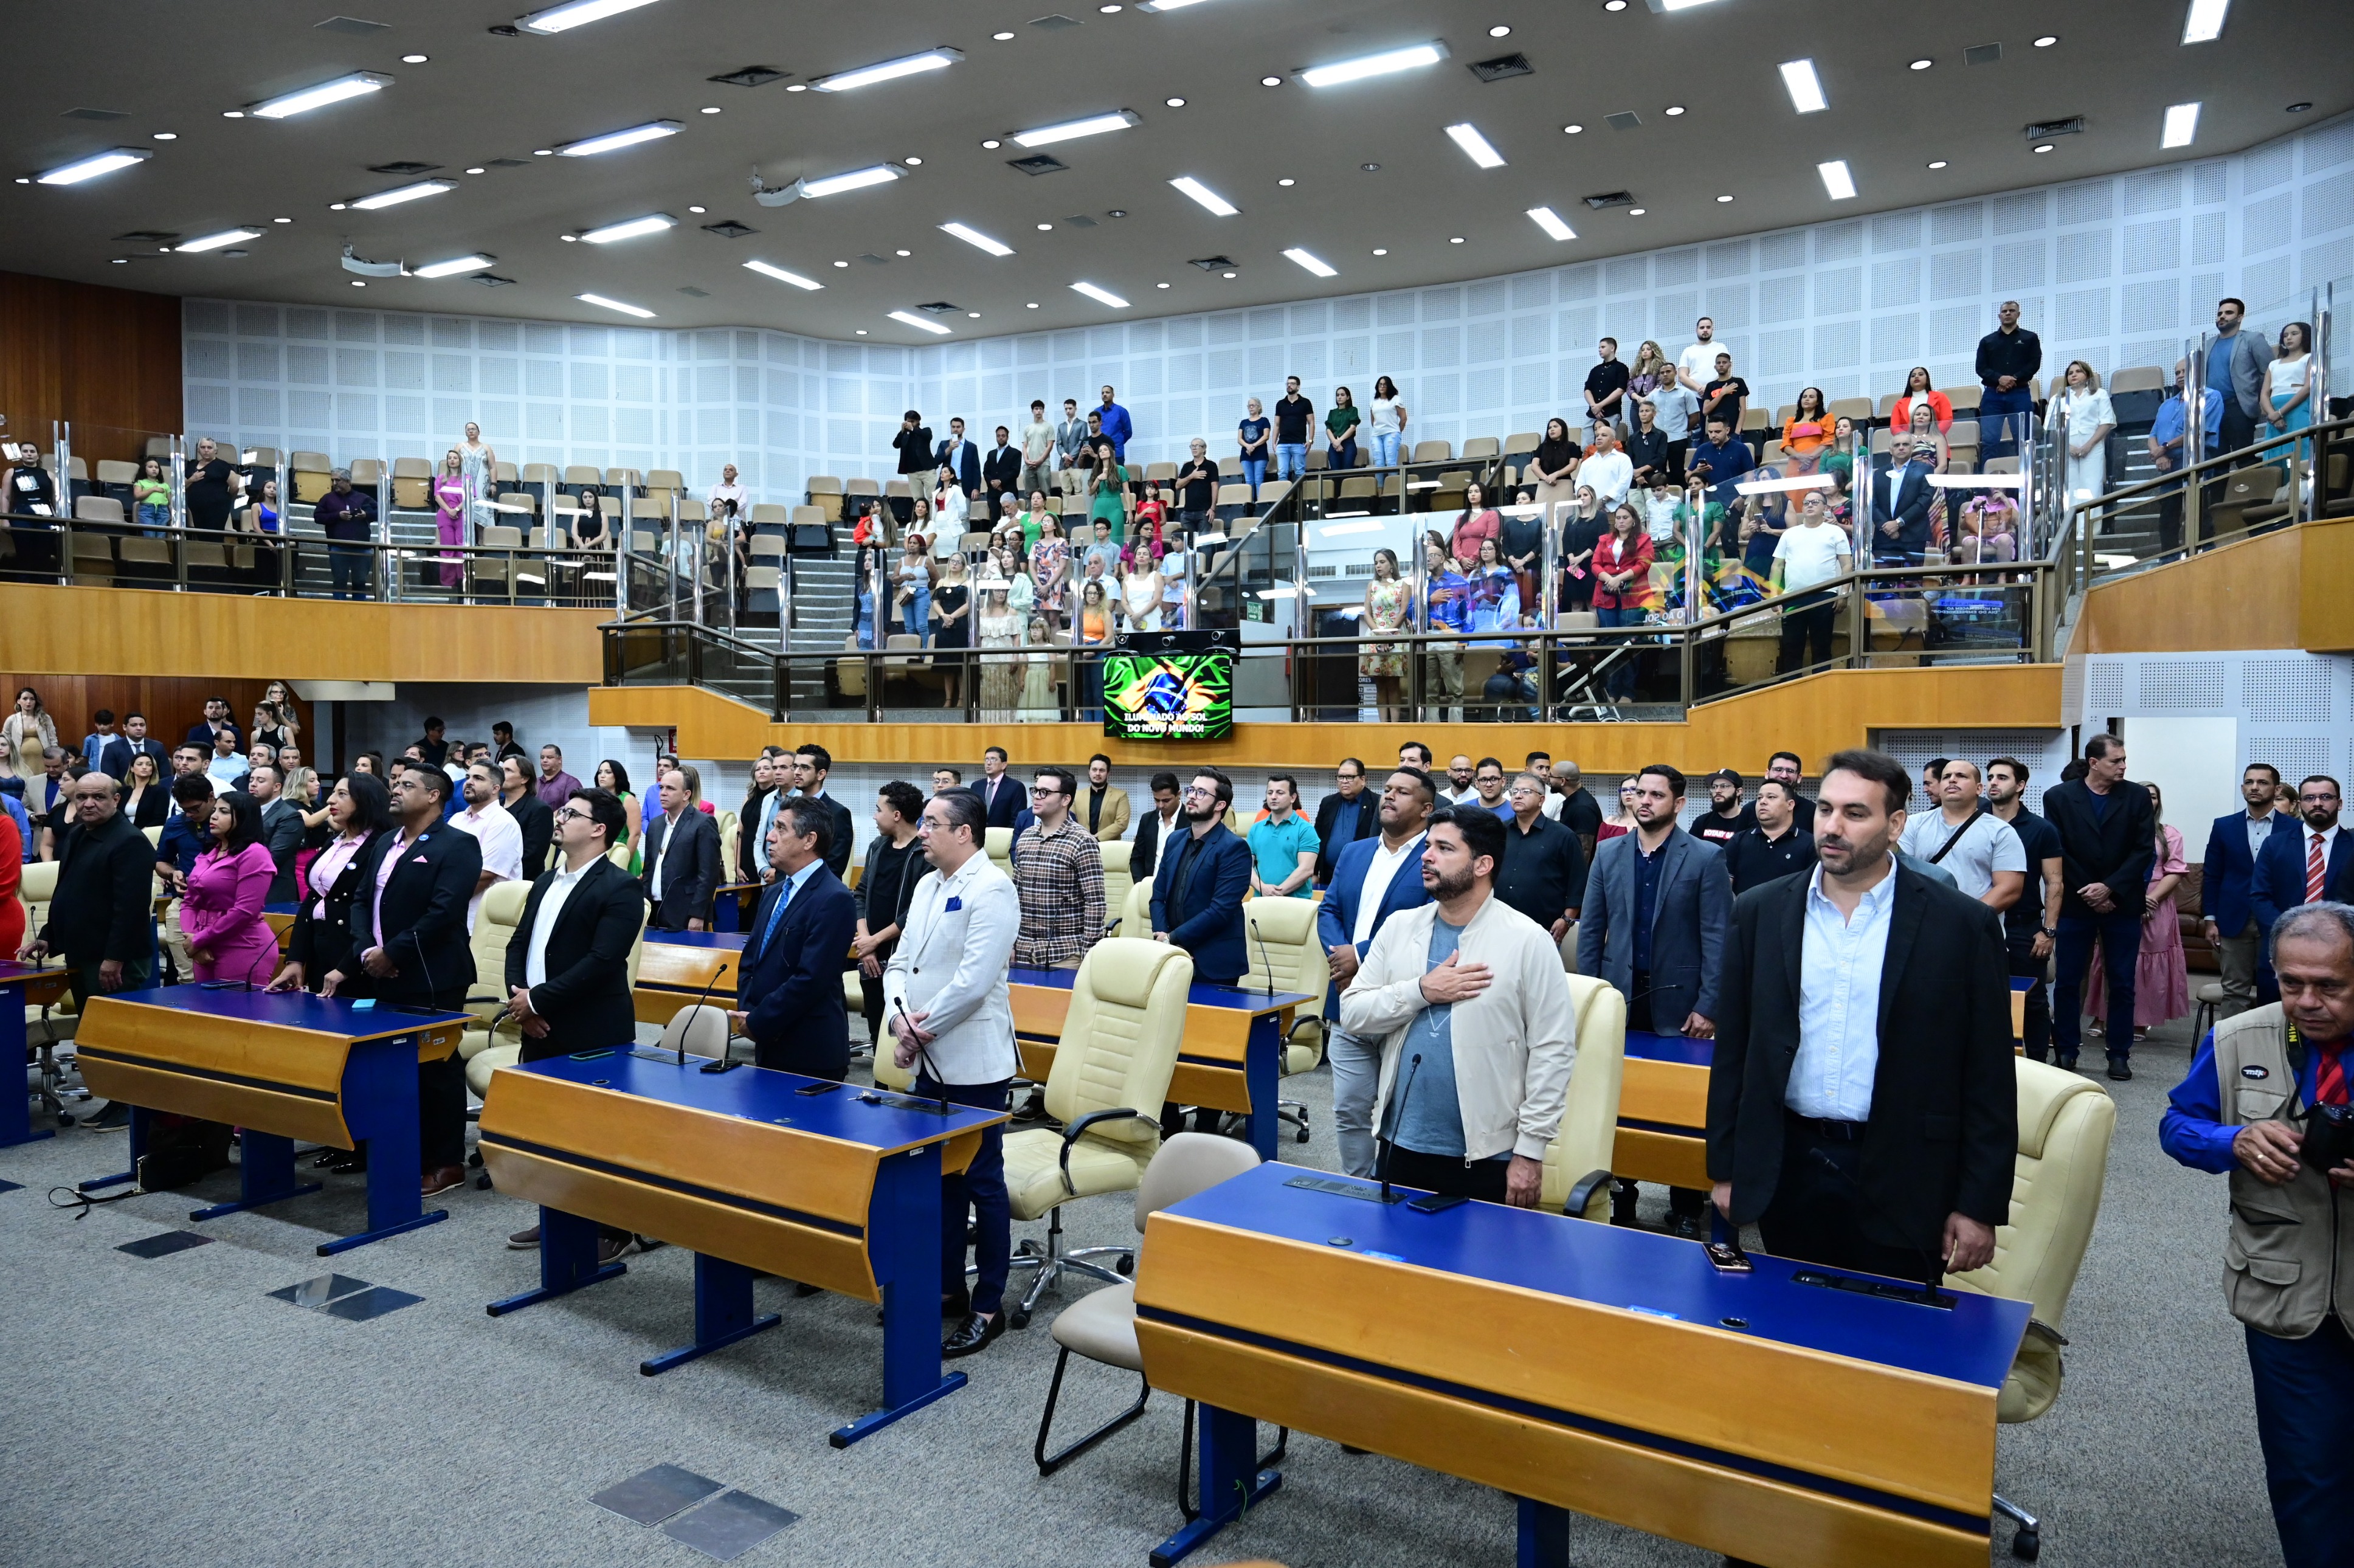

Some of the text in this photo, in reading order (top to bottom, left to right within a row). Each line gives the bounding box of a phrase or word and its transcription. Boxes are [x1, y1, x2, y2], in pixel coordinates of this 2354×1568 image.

[1127, 724, 1204, 733] DO NOVO MUNDO!
[1703, 829, 1726, 838] ROTARY
[2288, 1022, 2297, 1042] Nik
